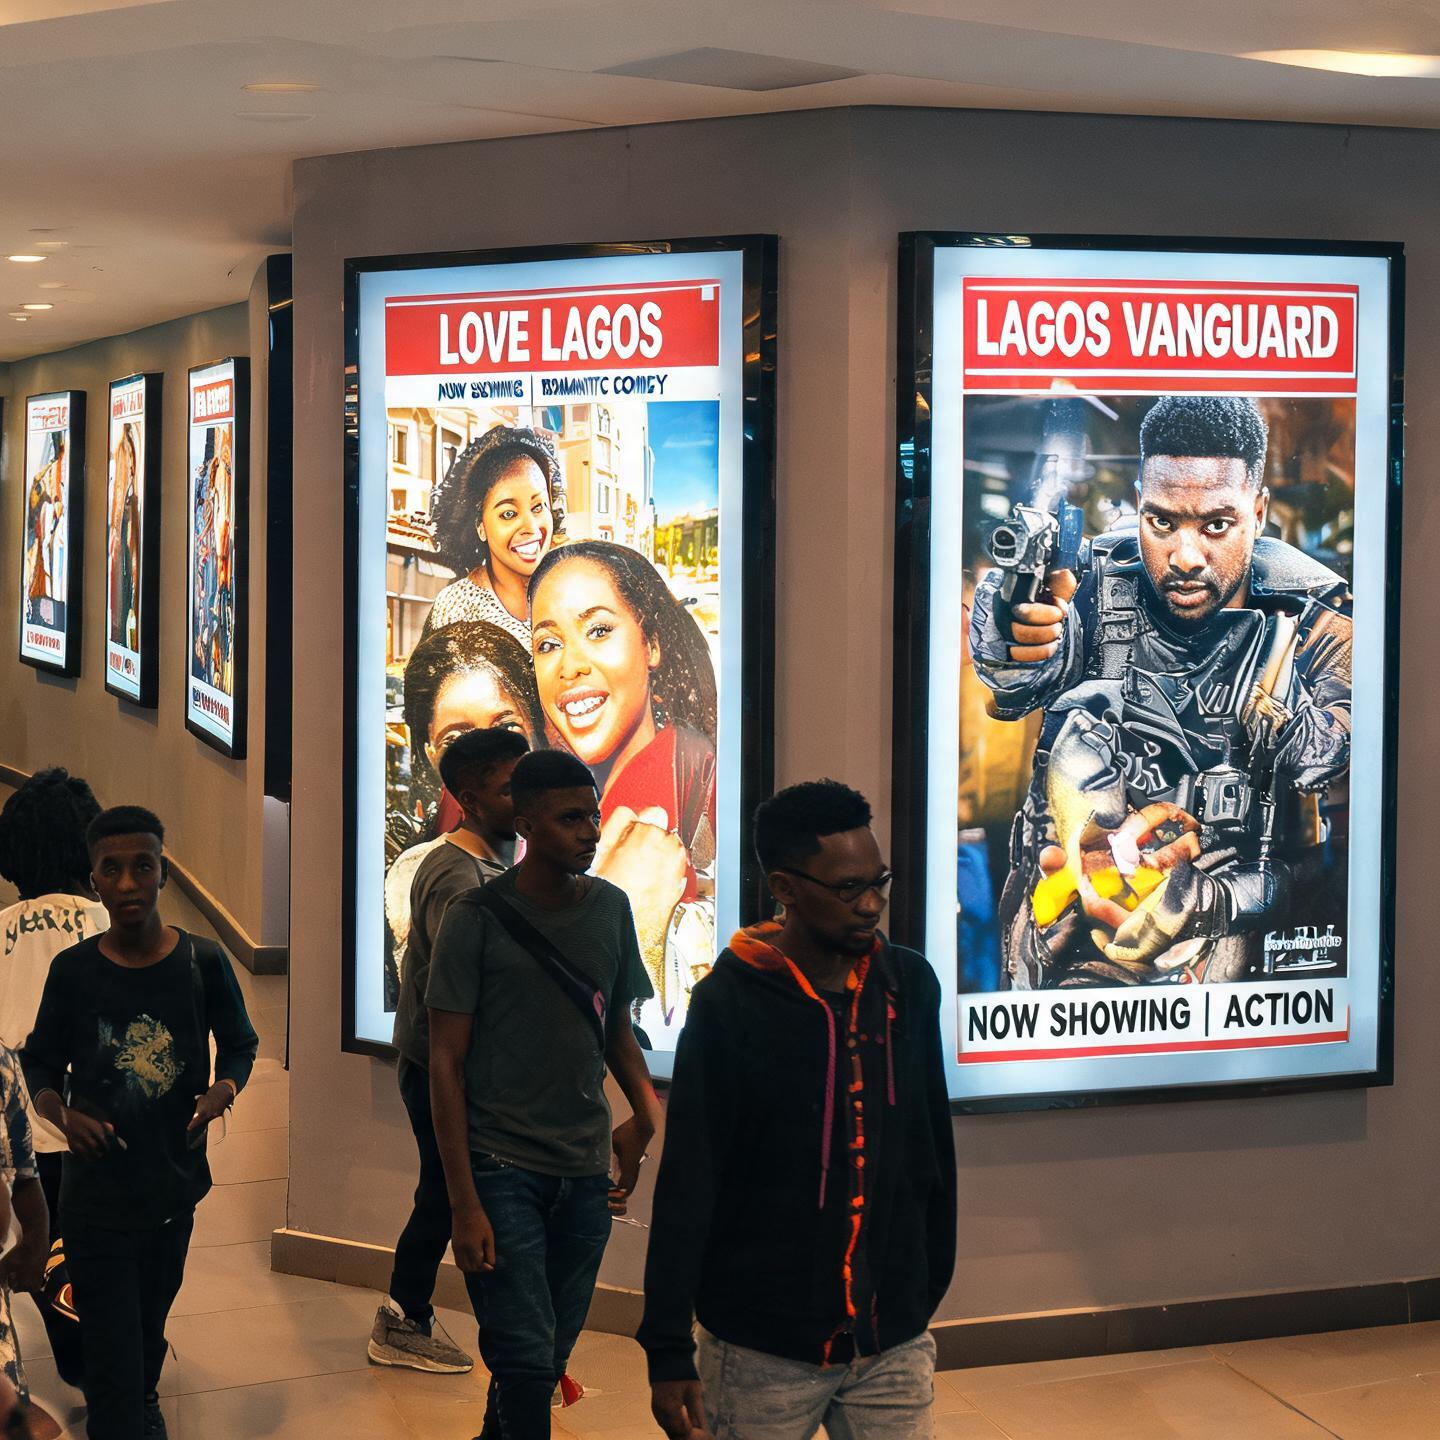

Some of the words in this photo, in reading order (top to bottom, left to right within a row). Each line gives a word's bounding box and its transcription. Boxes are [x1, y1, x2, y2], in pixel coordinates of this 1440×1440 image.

[439, 309, 531, 366] LOVE
[541, 300, 663, 362] LAGOS
[976, 298, 1111, 358] LAGOS
[1121, 301, 1339, 359] VANGUARD
[968, 1003, 1040, 1042] NOW
[1050, 997, 1191, 1037] SHOWING
[1223, 987, 1334, 1029] ACTION
